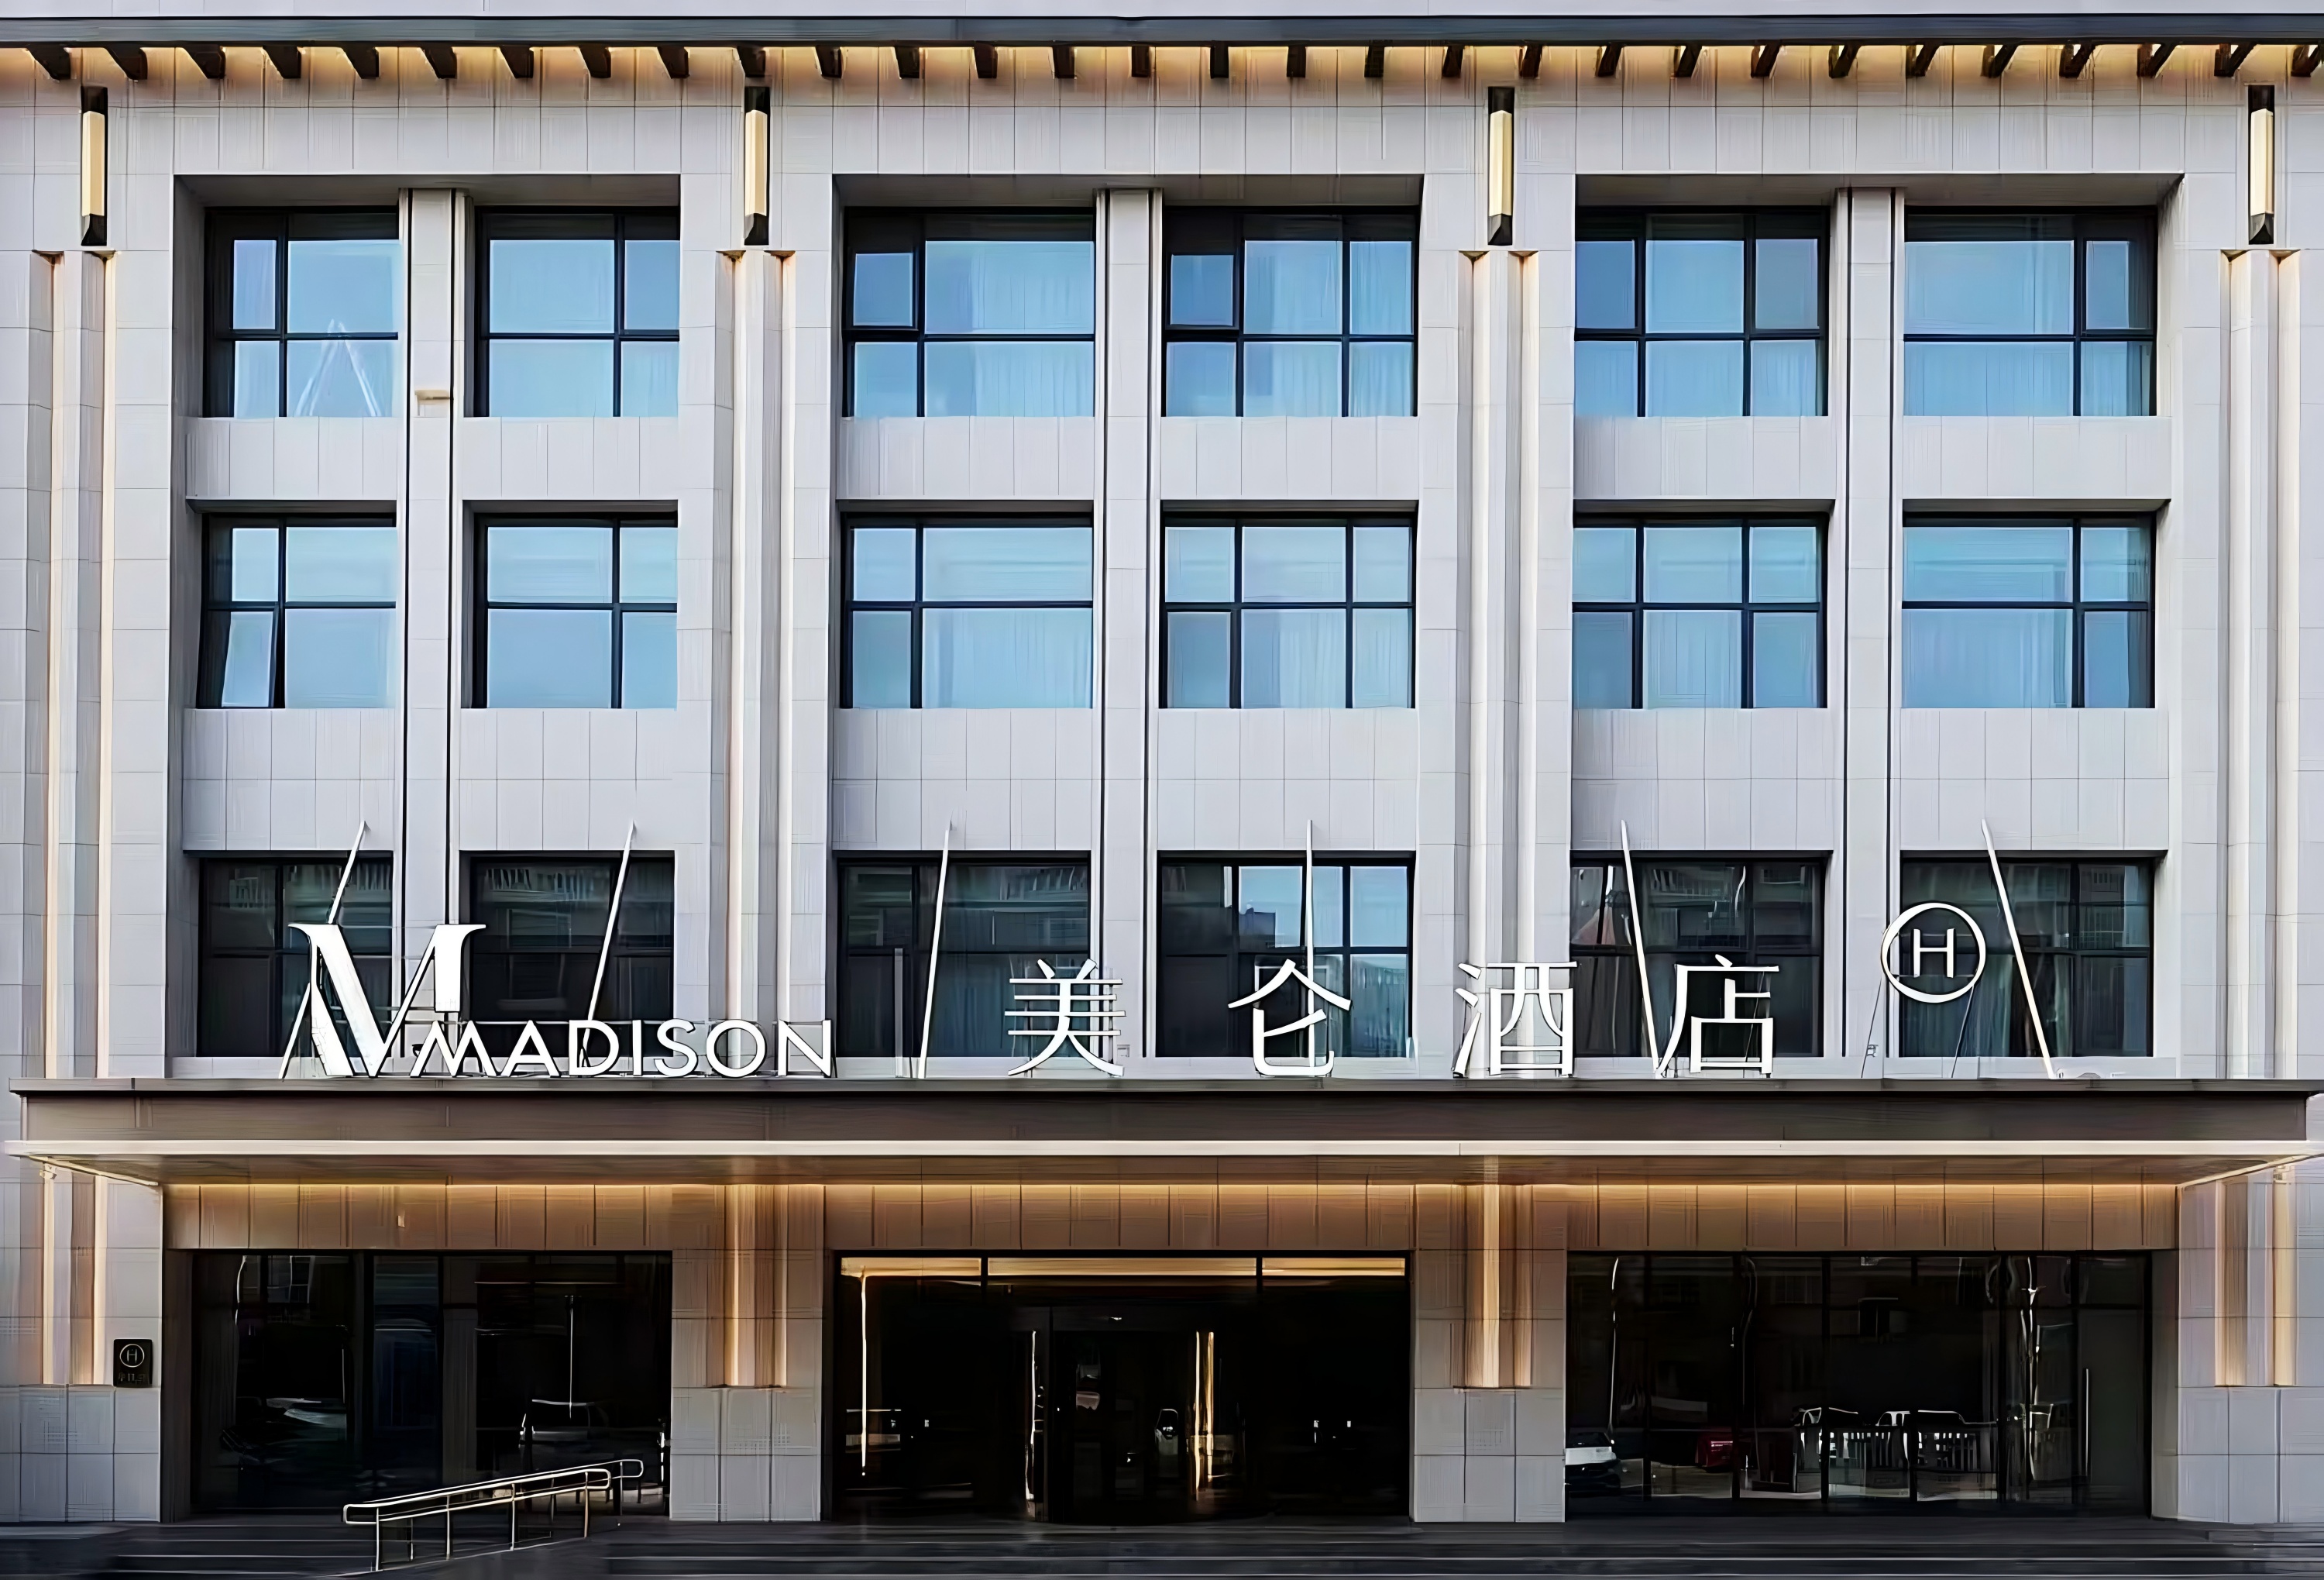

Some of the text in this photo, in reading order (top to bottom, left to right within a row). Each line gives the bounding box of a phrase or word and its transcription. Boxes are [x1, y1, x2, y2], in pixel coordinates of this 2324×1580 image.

[410, 1018, 834, 1078] MADISON
[1004, 954, 1779, 1079] 美仑酒店
